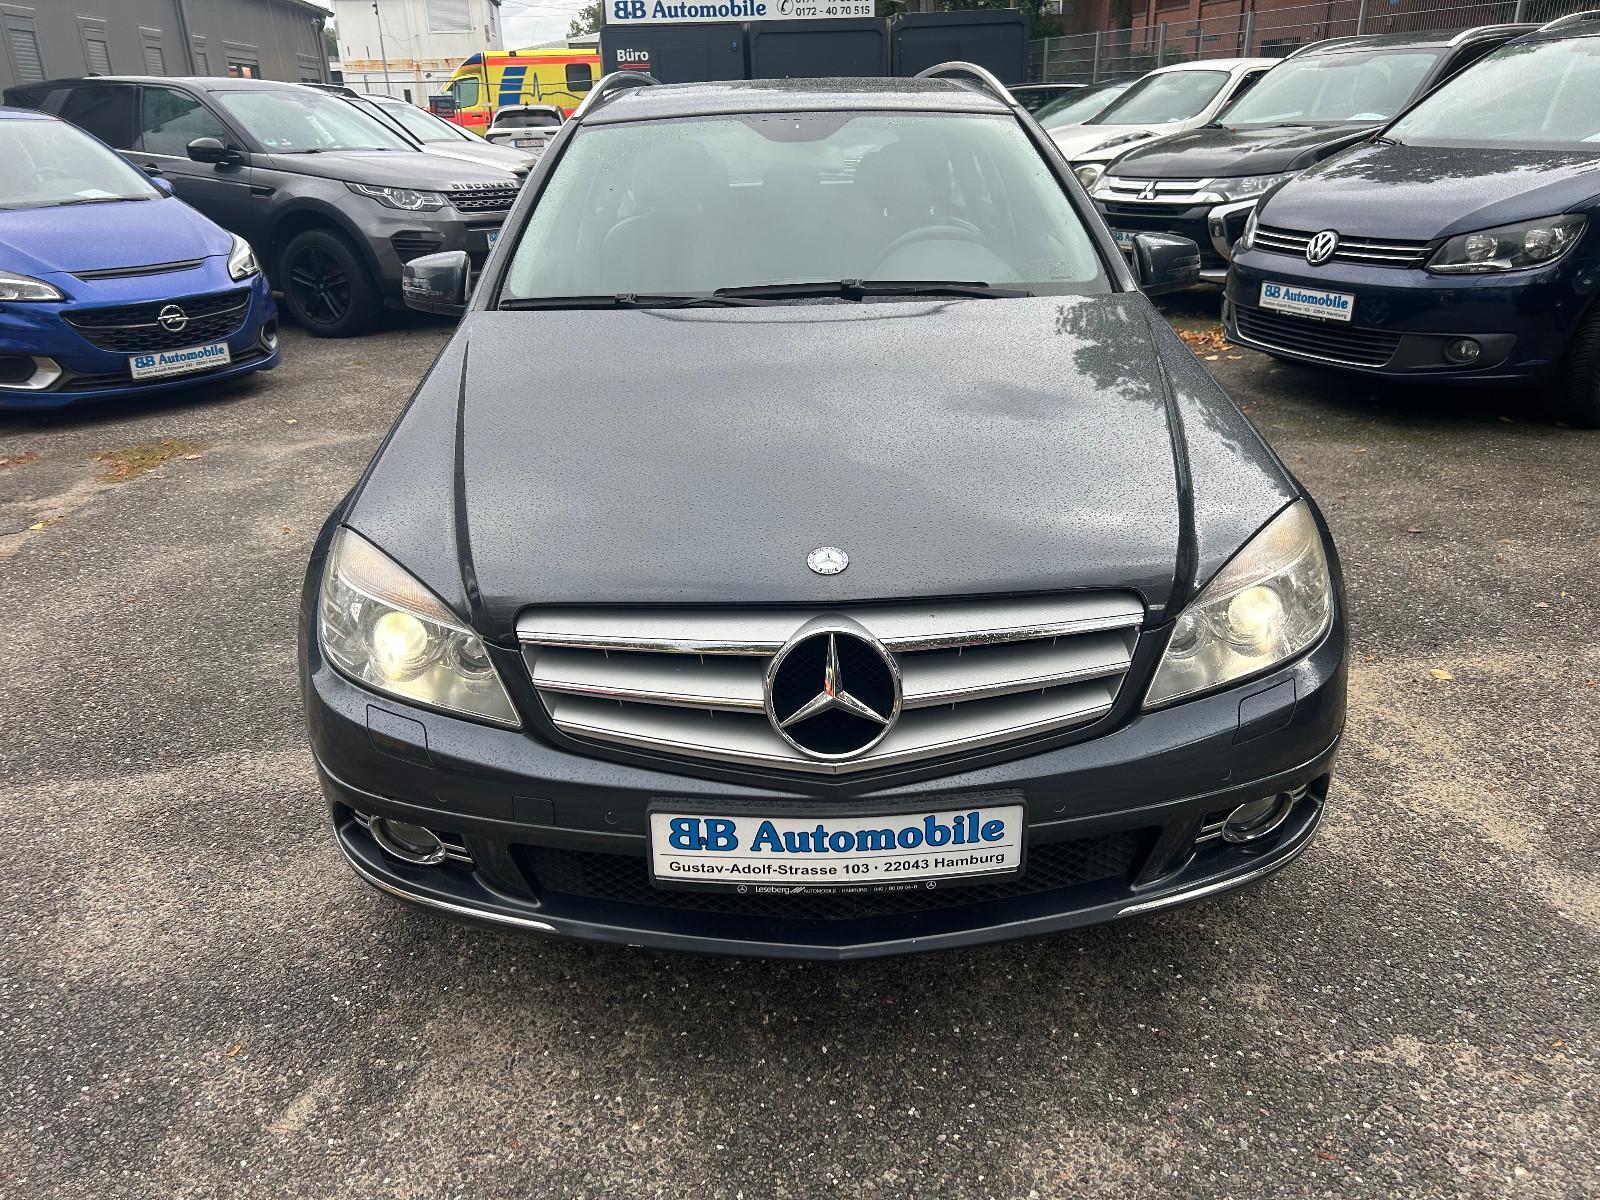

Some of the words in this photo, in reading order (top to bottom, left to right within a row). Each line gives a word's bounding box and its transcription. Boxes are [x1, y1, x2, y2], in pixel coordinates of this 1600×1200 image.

[652, 0, 767, 19] Automobile
[796, 7, 817, 16] 0172
[826, 7, 838, 15] 40
[841, 6, 852, 15] 70
[854, 6, 870, 15] 515
[616, 48, 649, 62] Büro
[1282, 287, 1349, 310] Automobile
[158, 344, 225, 365] Automobile
[750, 811, 1005, 853] Automobile
[669, 861, 838, 876] Gustav-Adolf-Strasse
[843, 863, 870, 875] 103
[883, 858, 930, 873] 22043
[934, 853, 1005, 869] Hamburg
[755, 885, 790, 895] Leseberg
